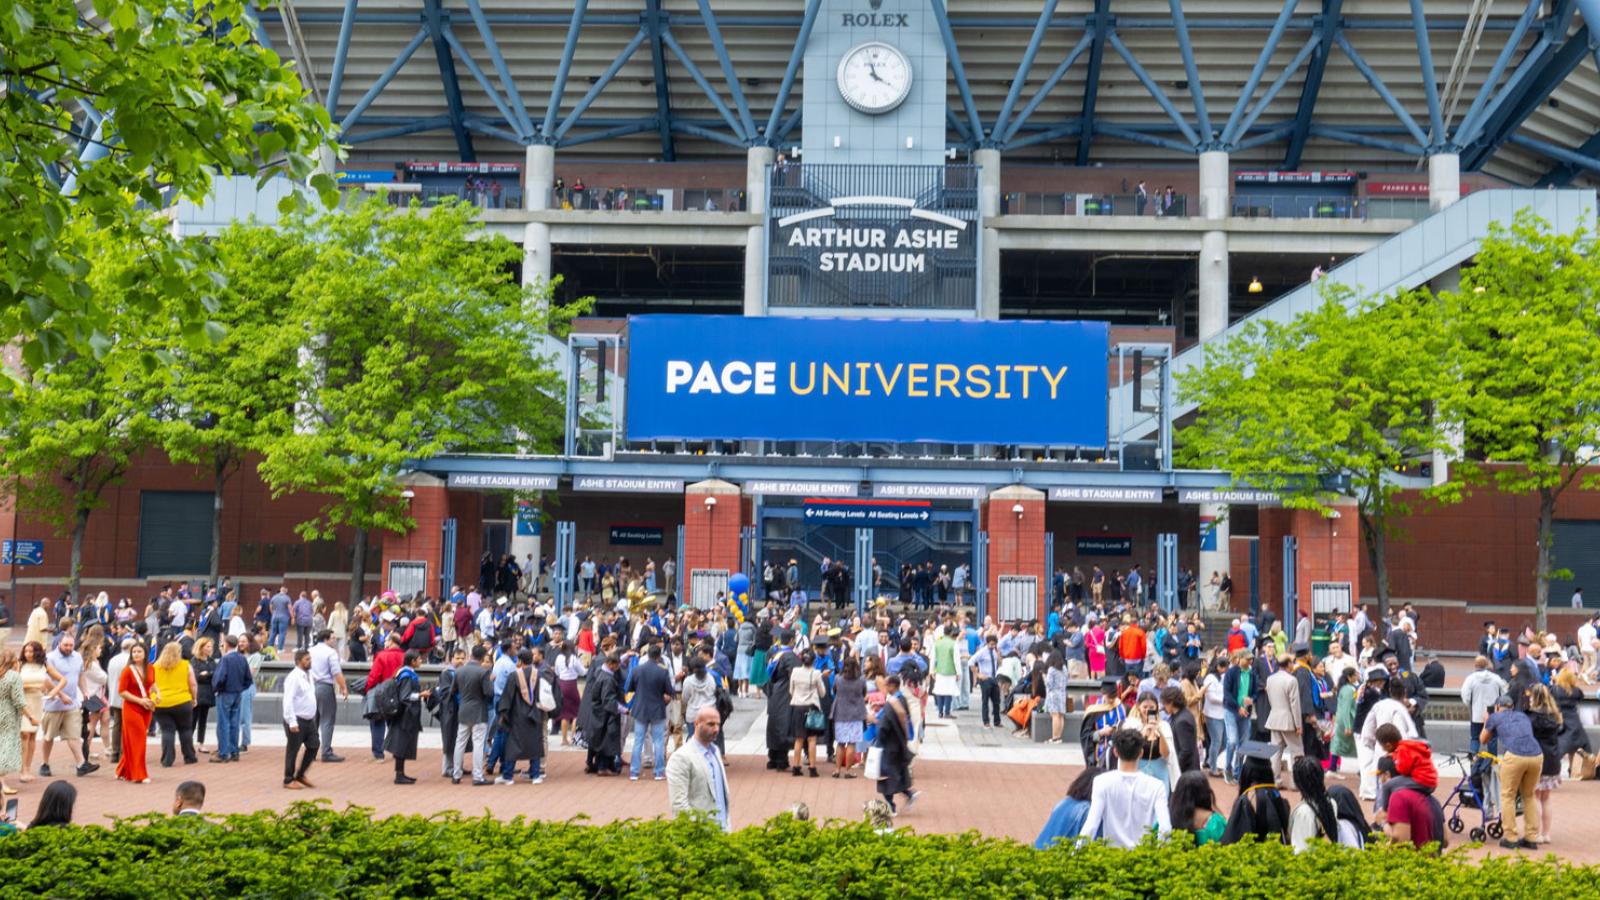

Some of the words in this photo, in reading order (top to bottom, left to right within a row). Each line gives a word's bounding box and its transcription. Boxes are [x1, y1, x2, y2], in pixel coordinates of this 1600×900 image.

[842, 13, 909, 27] ROLEX
[788, 227, 886, 249] ARTHUR
[894, 228, 960, 250] ASHE
[819, 252, 926, 275] STADIUM
[666, 360, 777, 396] PACE
[789, 361, 1069, 400] UNIVERSITY
[454, 476, 478, 486] ASHE
[480, 476, 519, 486] STADIUM
[521, 476, 551, 486] ENTRY
[580, 479, 603, 489] ASHE
[605, 479, 645, 489] STADIUM
[647, 479, 677, 489] ENTRY
[752, 482, 778, 493] ASHE
[779, 482, 818, 493] STADIUM
[820, 482, 851, 493] ENTRY
[880, 485, 905, 496] ASHE
[907, 485, 947, 496] STADIUM
[949, 485, 980, 496] ENTRY
[1055, 489, 1080, 499] ASHE
[1082, 489, 1122, 499] STADIUM
[1124, 489, 1155, 499] ENTRY
[1185, 491, 1211, 501] ASHE
[1212, 491, 1254, 501] STADIUM
[815, 509, 823, 517] All
[824, 509, 846, 519] Seating
[847, 510, 866, 519] Levels
[868, 511, 876, 519] All
[877, 511, 900, 521] Seating
[900, 512, 919, 520] Levels
